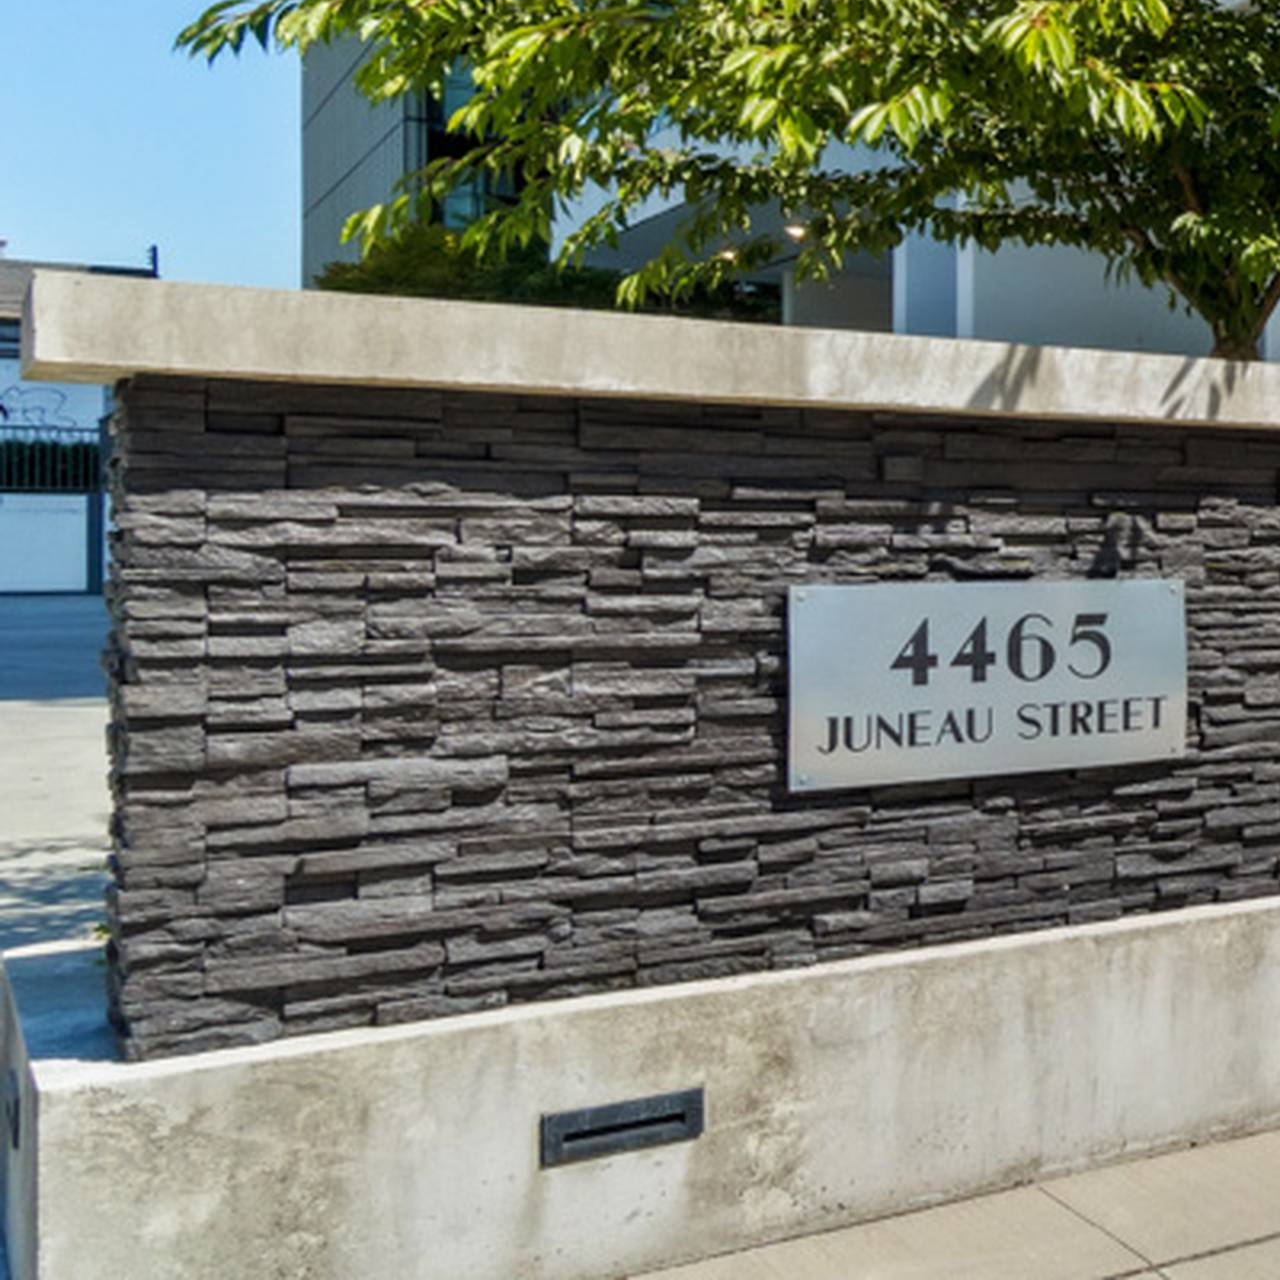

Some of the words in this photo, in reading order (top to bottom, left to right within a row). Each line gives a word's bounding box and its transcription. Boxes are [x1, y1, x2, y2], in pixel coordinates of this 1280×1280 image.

[889, 612, 1112, 686] 4465
[818, 706, 994, 755] JUNEAU
[1016, 695, 1169, 740] STREET
